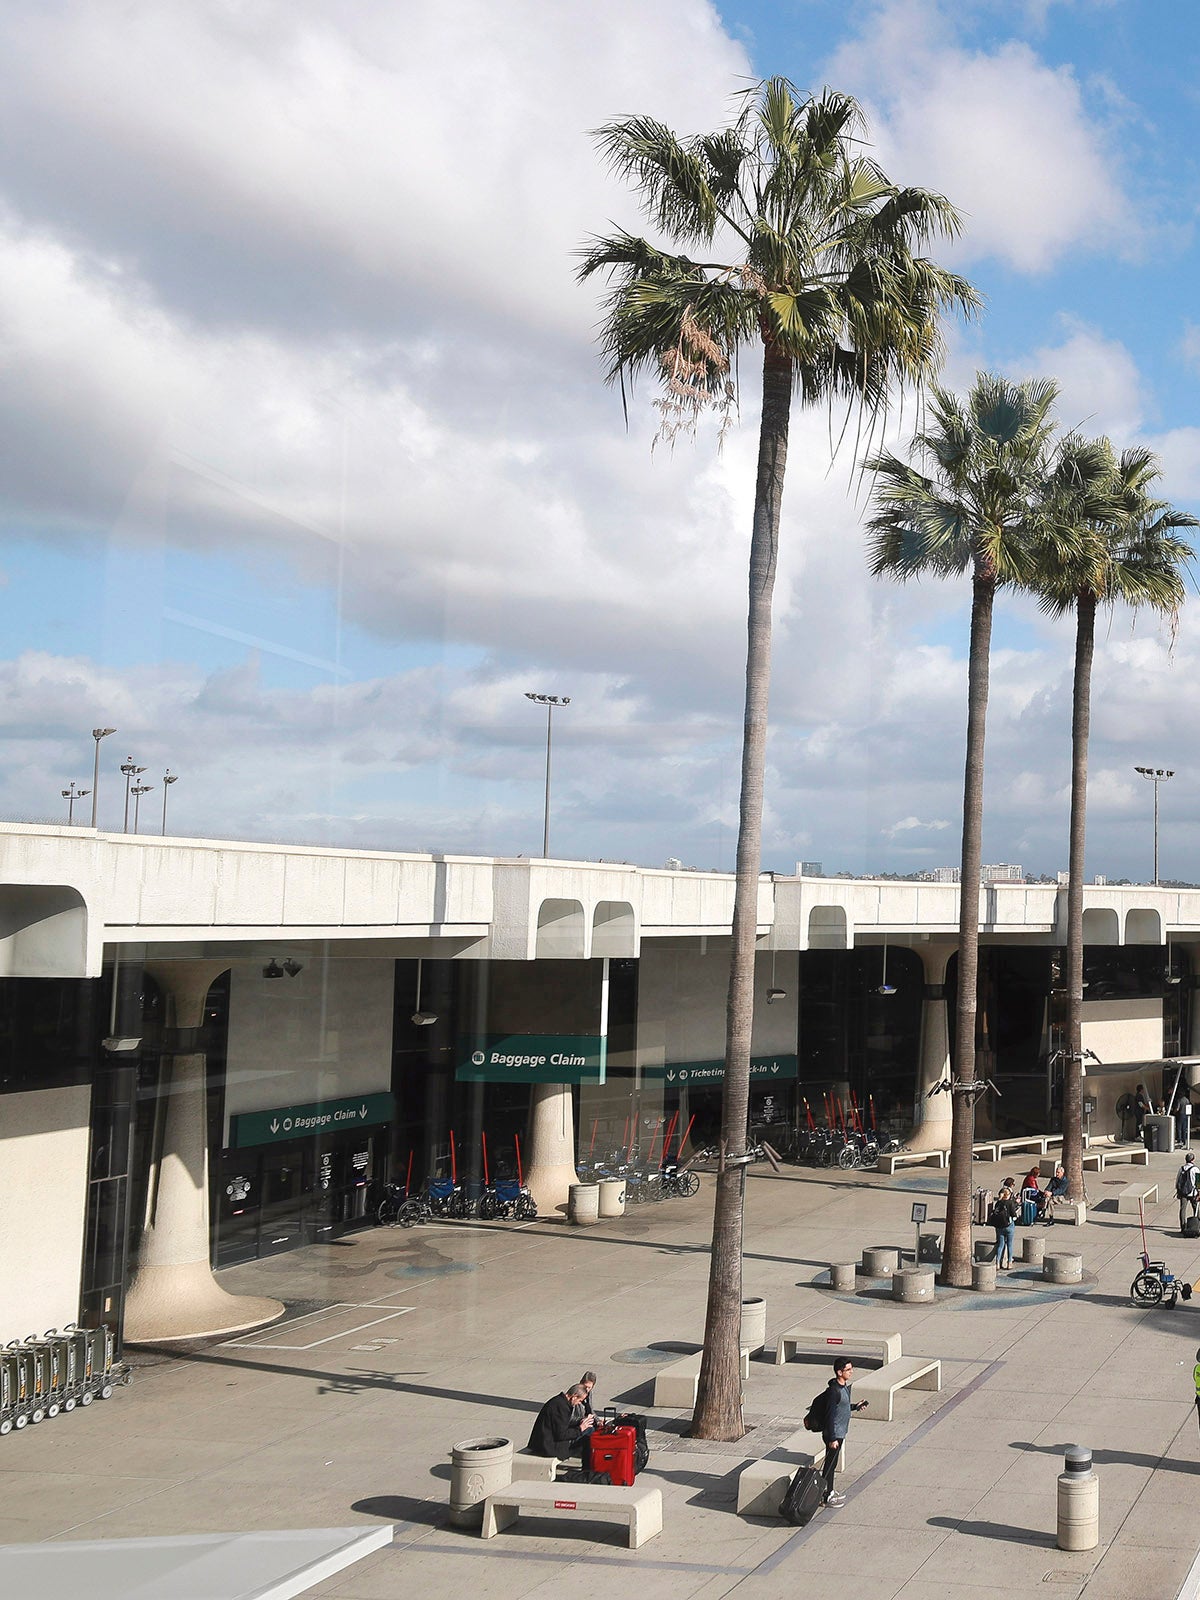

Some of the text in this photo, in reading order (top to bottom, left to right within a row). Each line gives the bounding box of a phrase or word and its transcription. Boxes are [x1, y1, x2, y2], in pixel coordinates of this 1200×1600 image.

[490, 1053, 586, 1067] Baggage Claim
[294, 1108, 356, 1129] Baggage Claim
